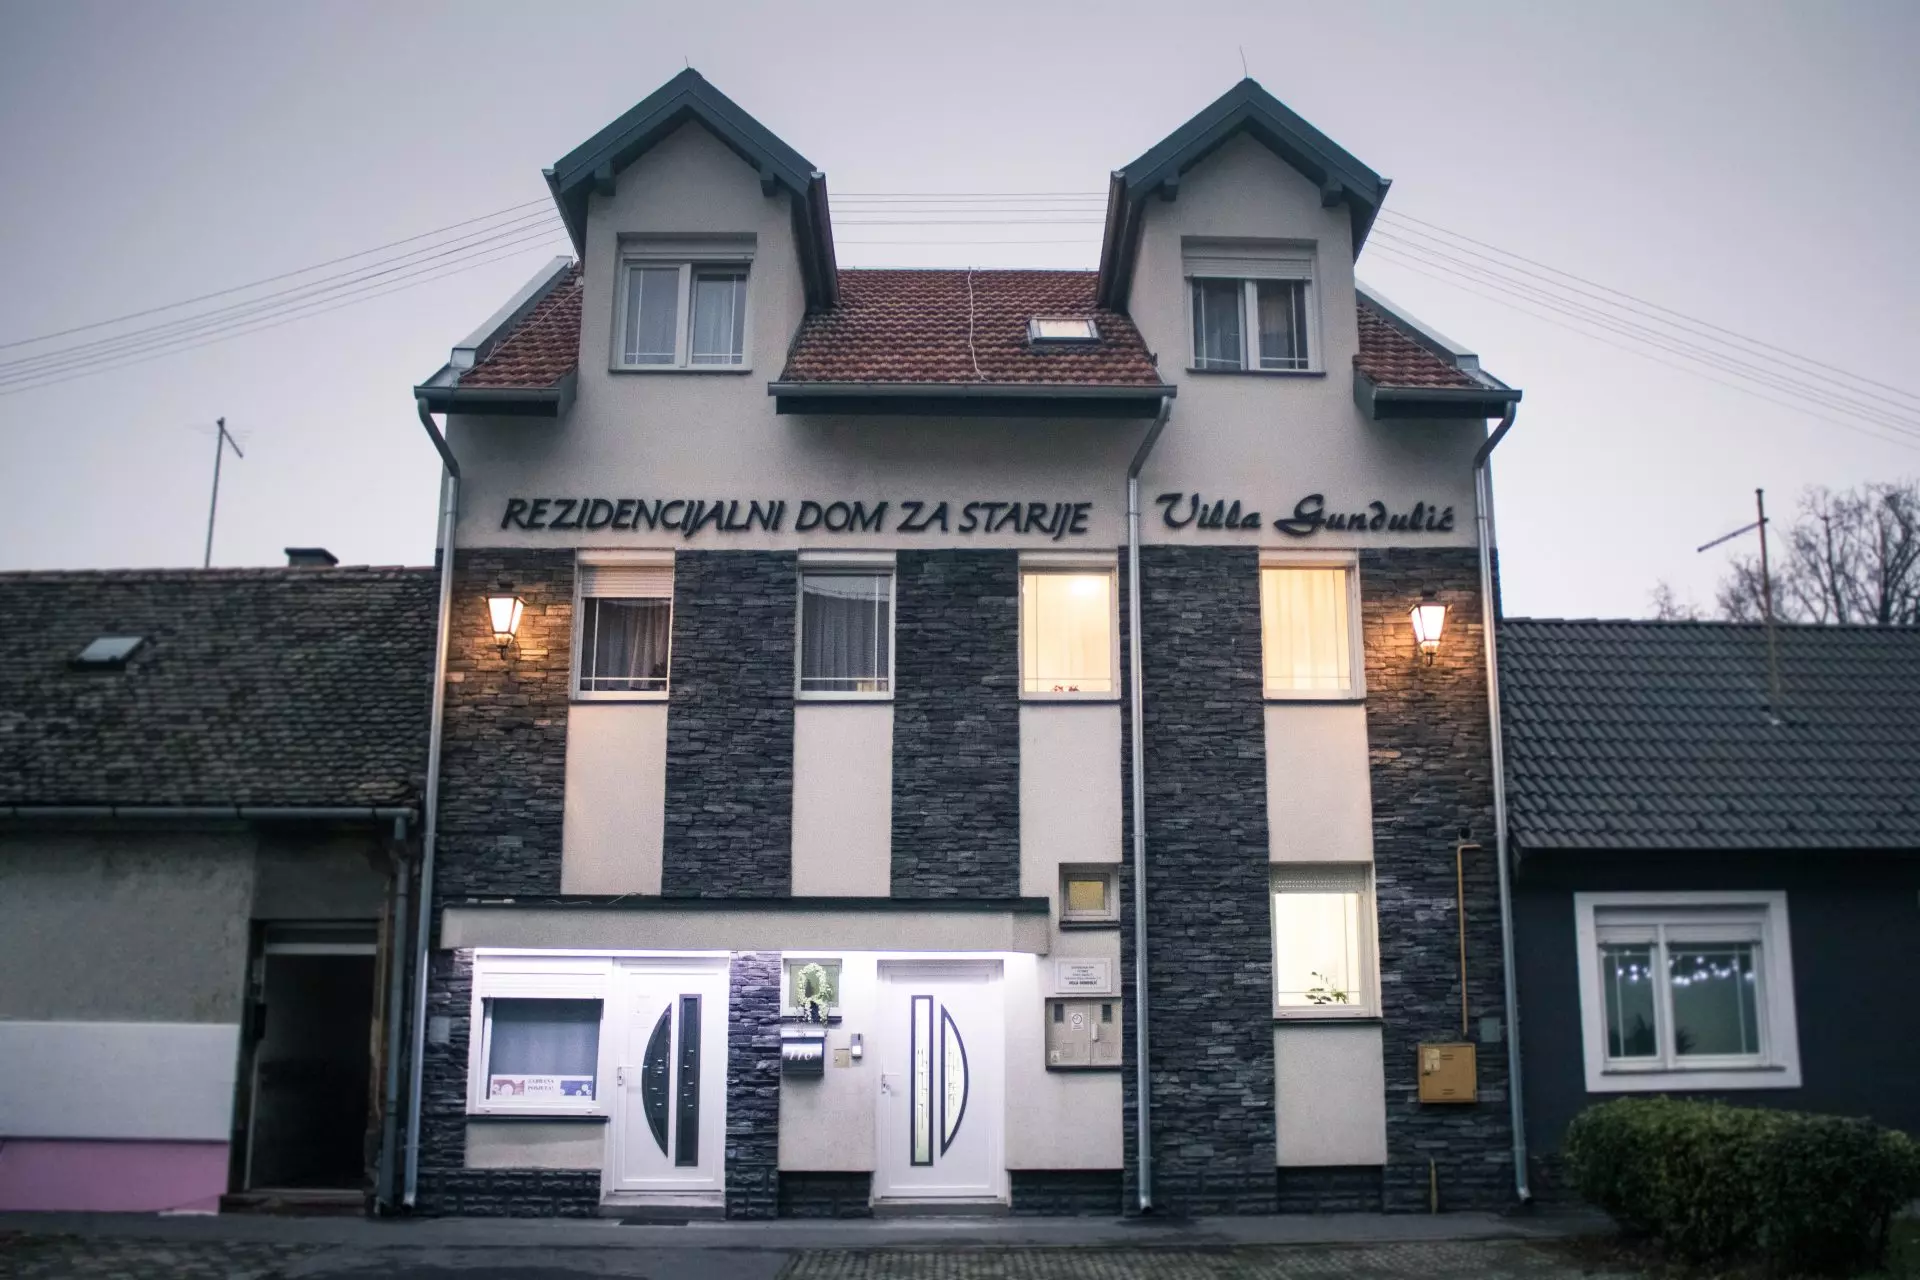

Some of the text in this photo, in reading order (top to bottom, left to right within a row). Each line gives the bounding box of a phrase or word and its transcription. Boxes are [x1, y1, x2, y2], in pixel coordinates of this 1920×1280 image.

[500, 499, 1093, 541] REZIDENCIJALNI DOM ZA STARIJE
[1156, 492, 1454, 536] Villa Gundulić
